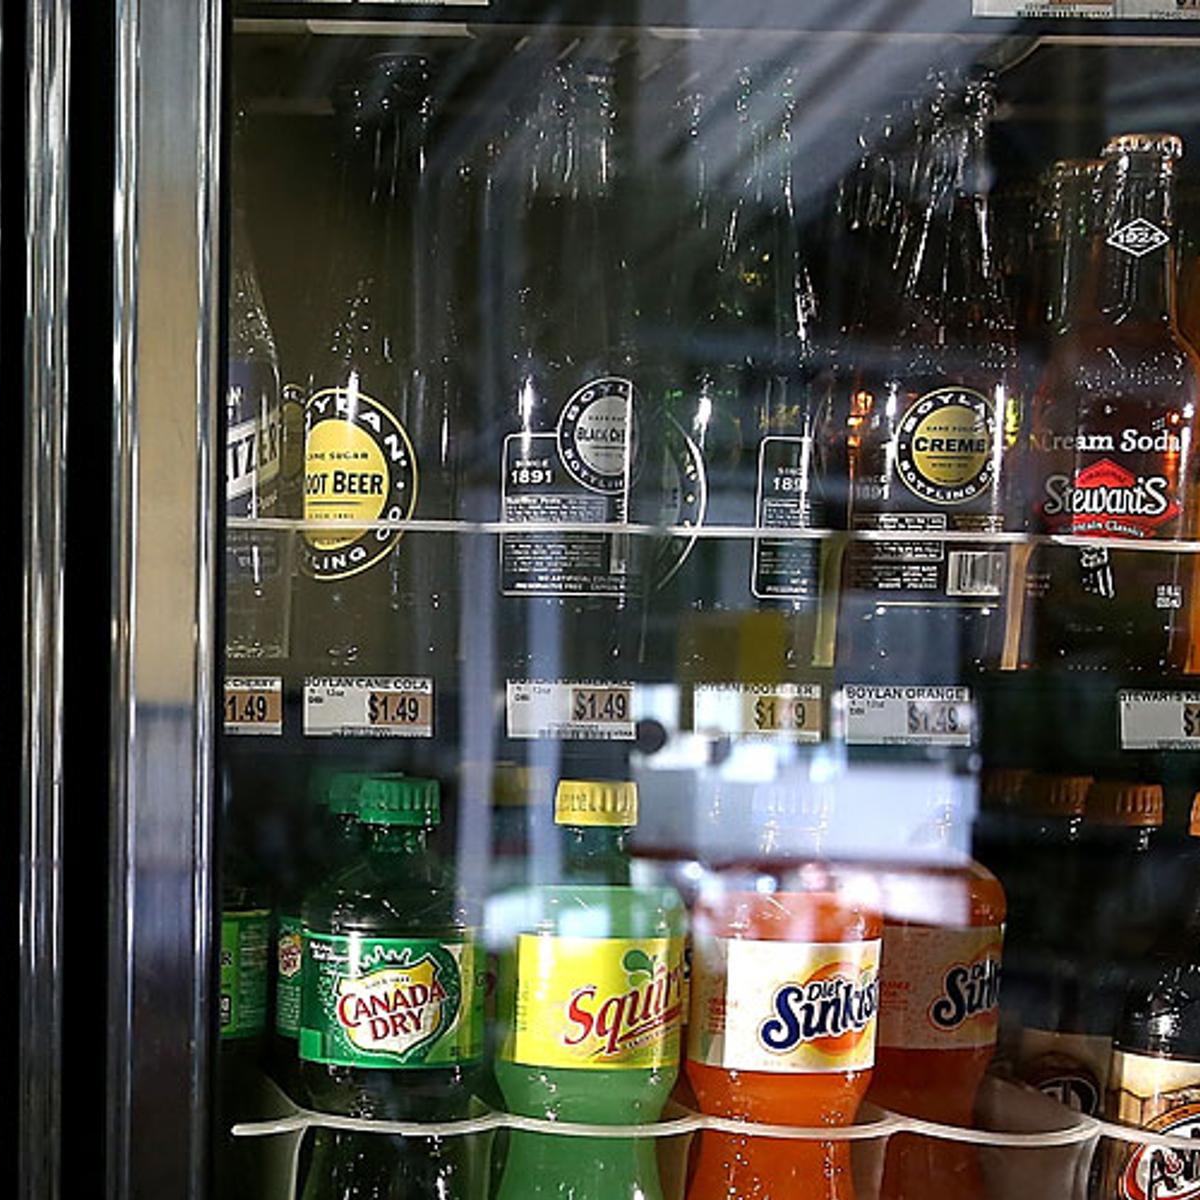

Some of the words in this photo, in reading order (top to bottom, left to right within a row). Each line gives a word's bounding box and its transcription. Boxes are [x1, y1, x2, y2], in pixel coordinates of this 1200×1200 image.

[914, 436, 987, 453] CREME
[1119, 428, 1182, 452] Soda
[305, 474, 328, 494] OOT
[333, 470, 383, 495] BEER
[512, 469, 553, 484] 1891
[574, 692, 627, 720] $1.49
[846, 687, 901, 699] BOYLAN
[905, 688, 965, 699] ORANGE
[227, 695, 268, 722] 1.49
[369, 694, 419, 724] $1.49
[754, 700, 806, 728] $1.9
[907, 704, 959, 732] $1.49
[338, 979, 448, 1028] CANADA
[808, 978, 843, 1002] Diet
[370, 1007, 425, 1041] DRY
